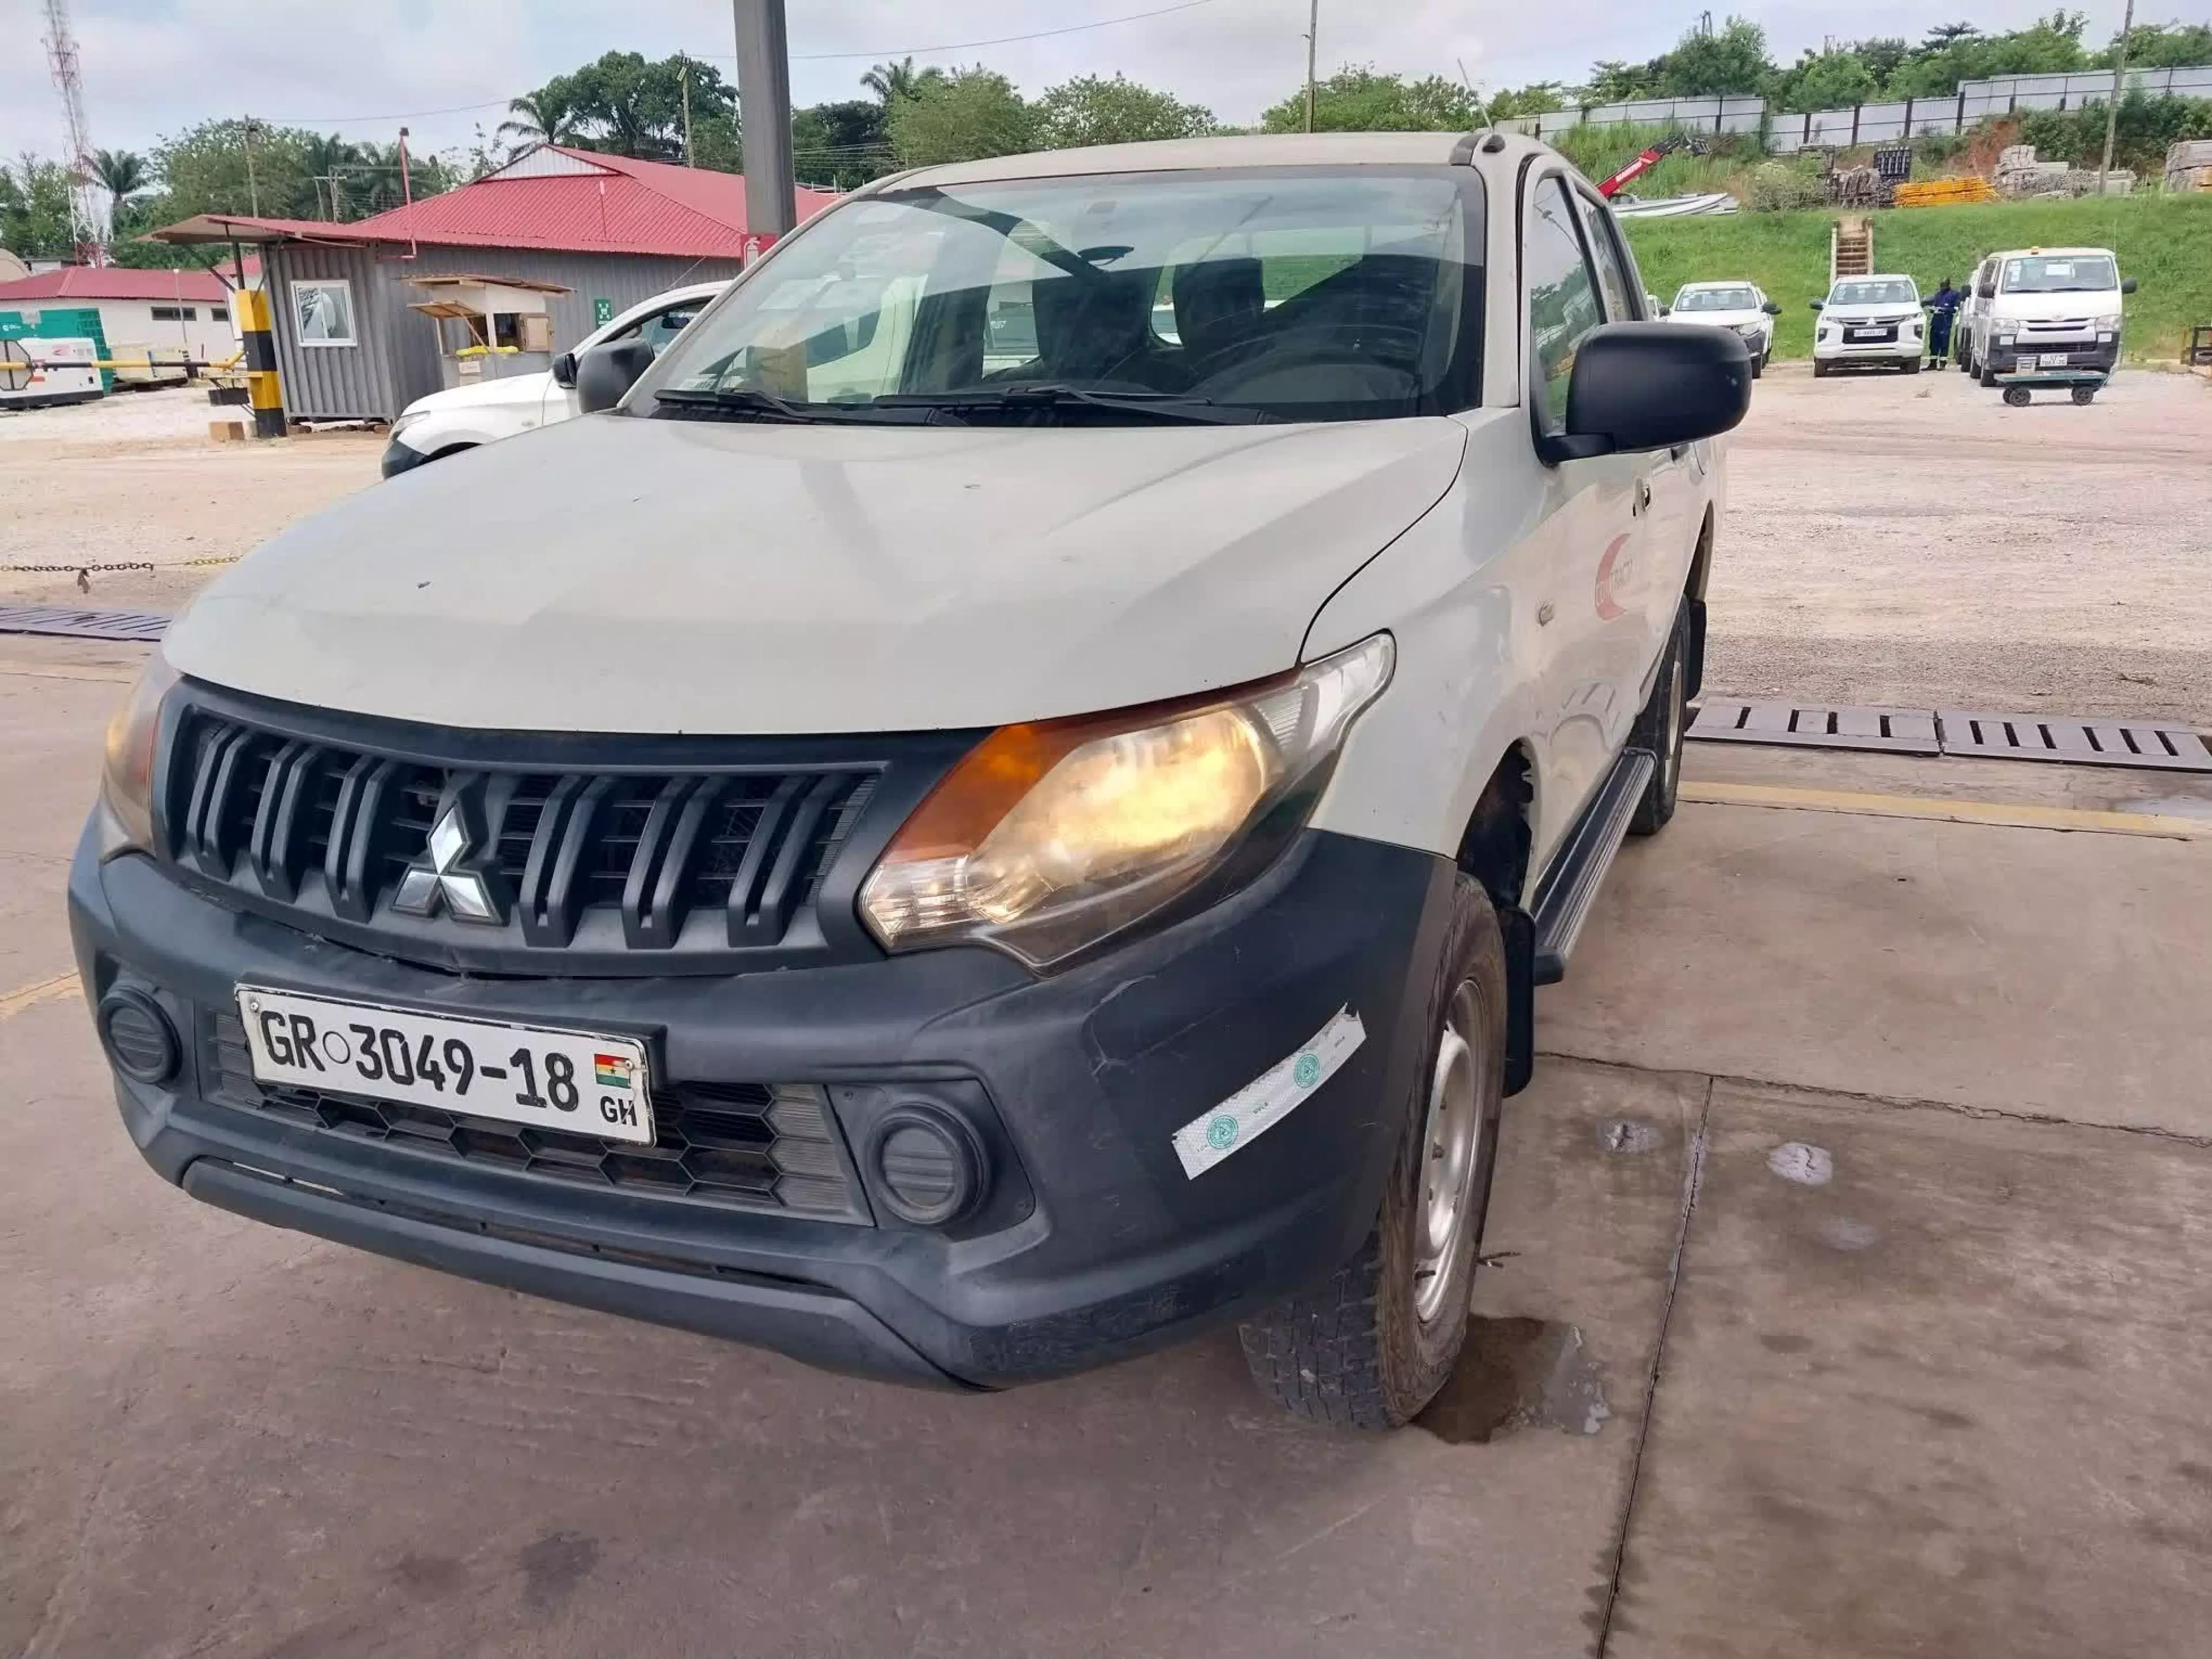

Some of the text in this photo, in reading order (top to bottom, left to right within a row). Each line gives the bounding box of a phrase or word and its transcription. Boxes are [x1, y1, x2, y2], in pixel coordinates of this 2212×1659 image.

[260, 1010, 579, 1112] GR 3049-18
[600, 1096, 637, 1126] GH
